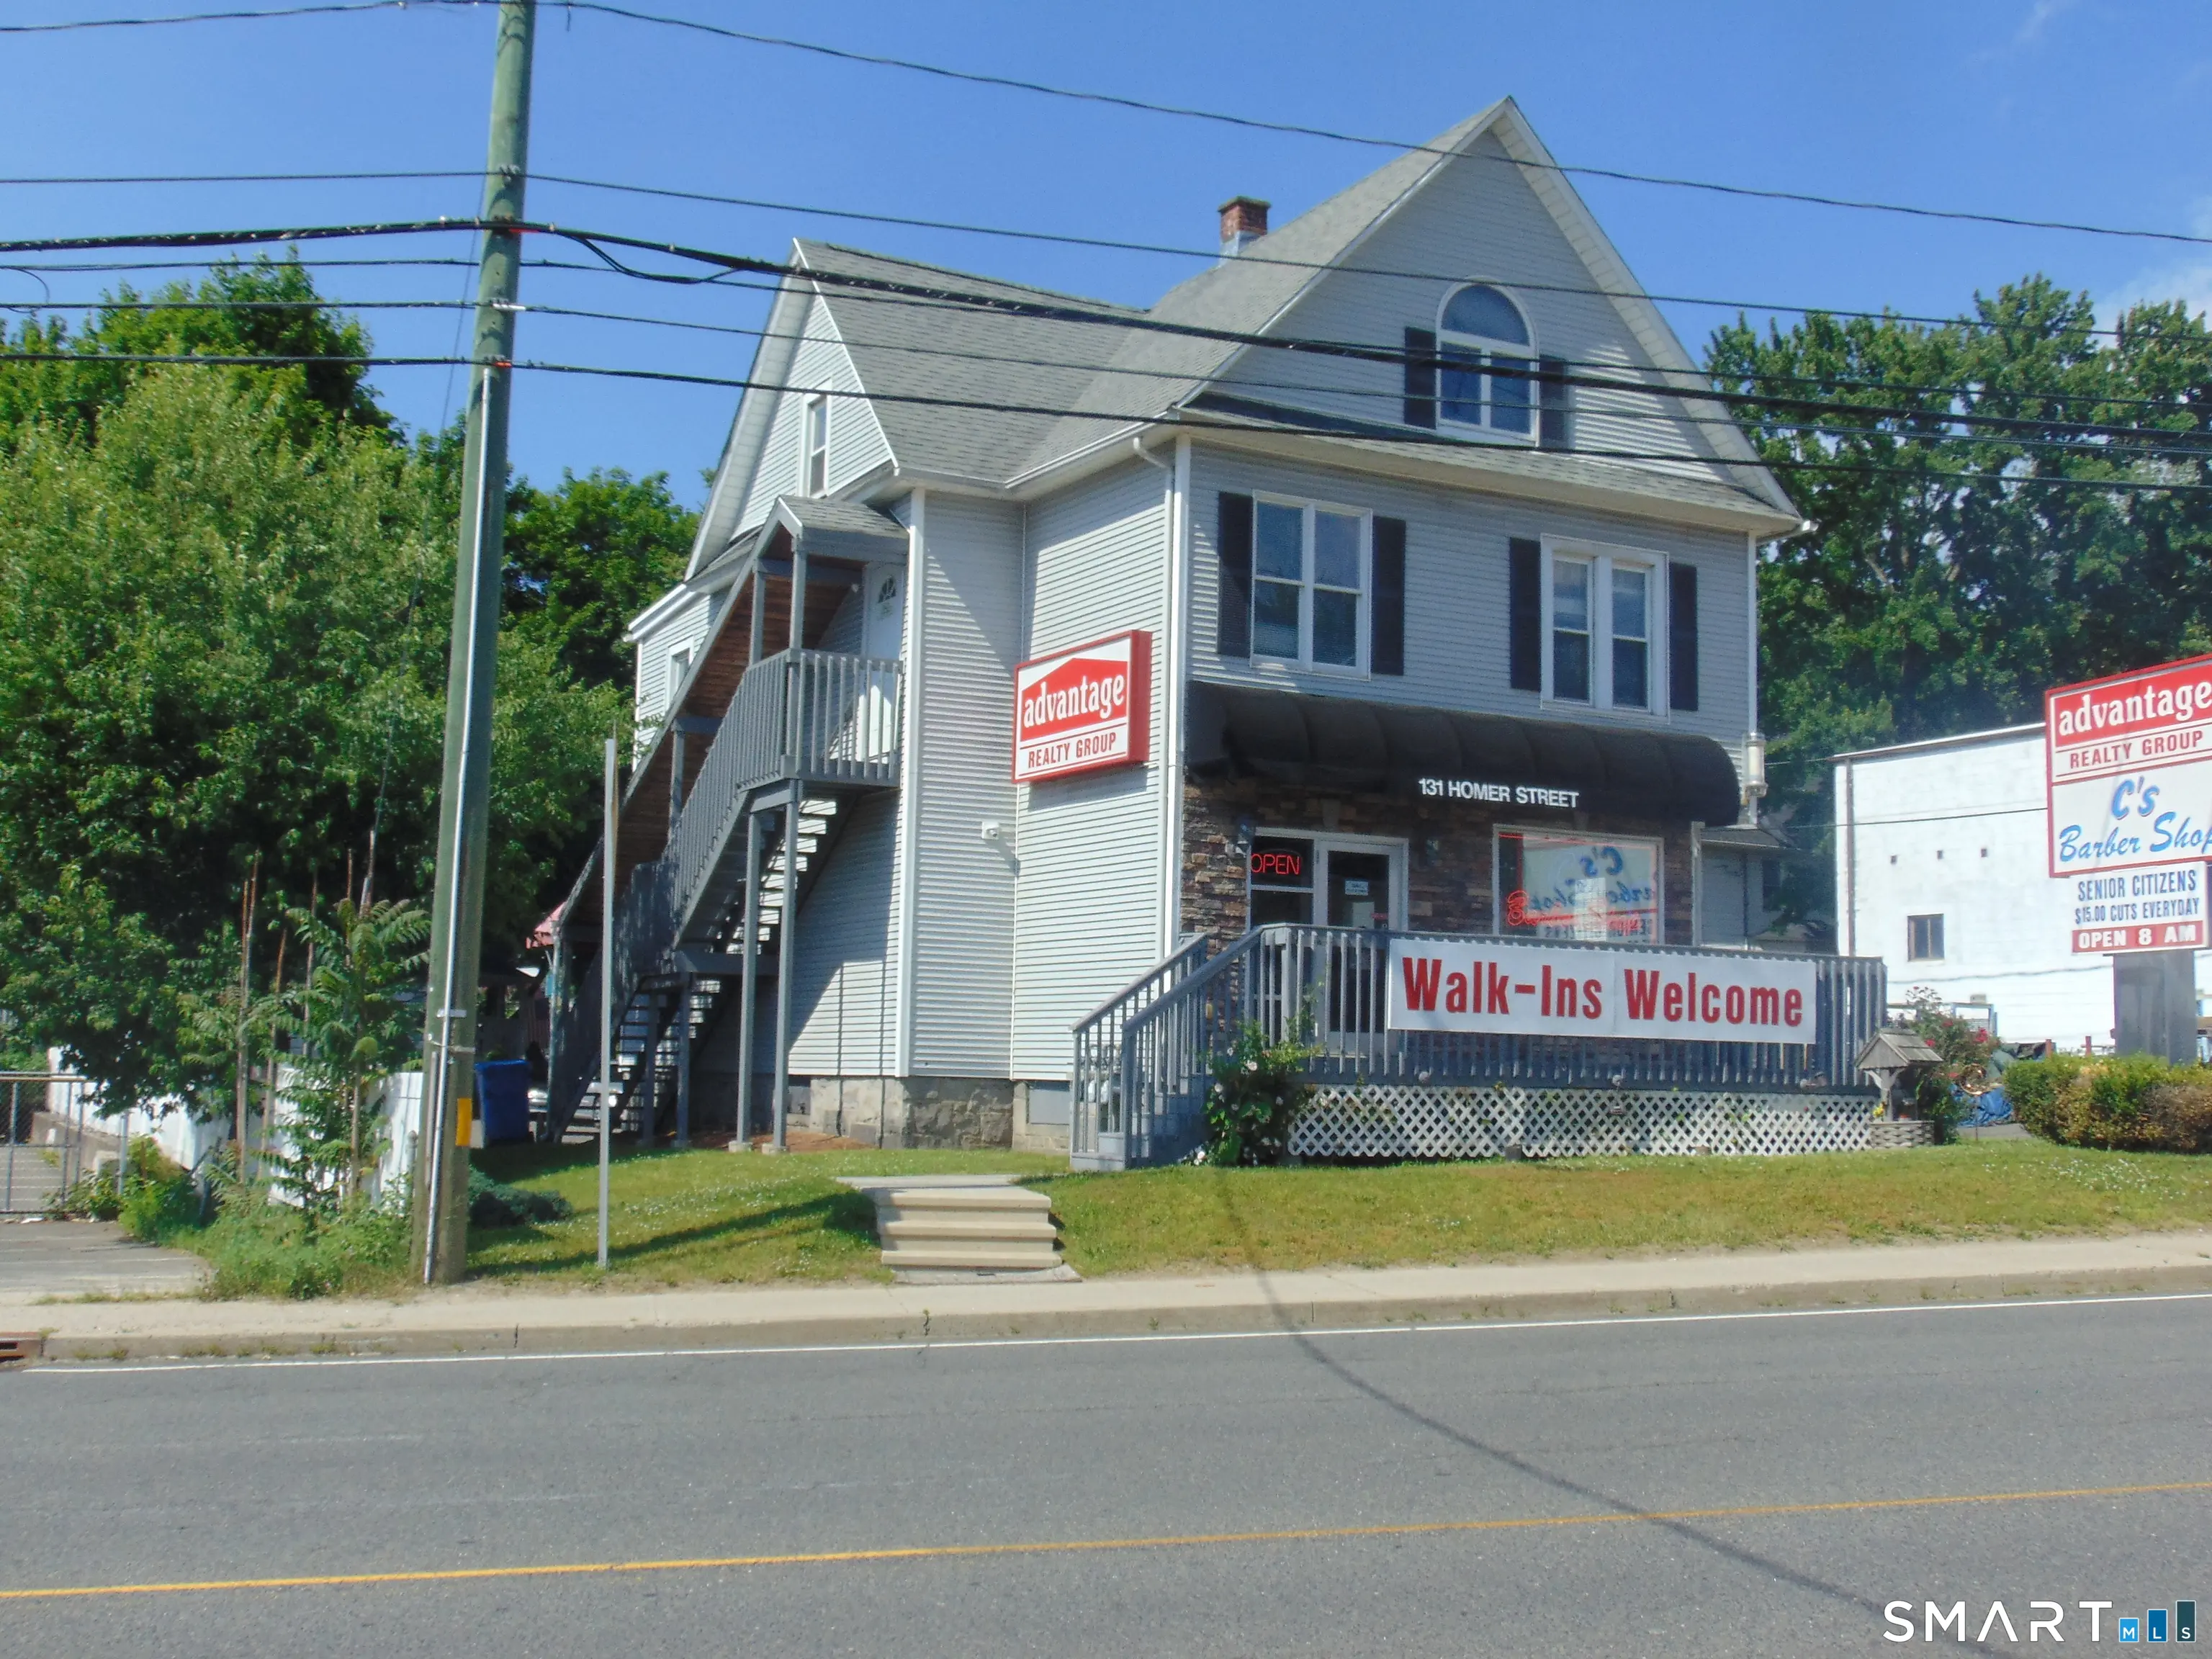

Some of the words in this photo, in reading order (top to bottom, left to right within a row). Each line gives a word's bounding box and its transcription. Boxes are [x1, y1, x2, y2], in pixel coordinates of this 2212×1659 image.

[1023, 675, 1125, 728] advantage
[2059, 681, 2212, 736] advantage
[1028, 743, 1071, 768] REALTY
[1076, 732, 1116, 758] GROUP
[2070, 742, 2132, 768] REALTY
[2142, 730, 2203, 755] GROUP
[1418, 778, 1443, 796] 131
[1448, 780, 1511, 802] HOMER
[1516, 786, 1580, 808] STREET
[2111, 775, 2160, 820] C's
[2059, 824, 2141, 862] Barber
[1251, 853, 1300, 875] OPEN
[2078, 876, 2125, 902] SENIOR
[2132, 869, 2196, 896] CITIZENS
[2075, 905, 2106, 925] $15.00
[2110, 903, 2137, 922] CUTS
[2143, 897, 2199, 919] EVERYDAY
[2079, 930, 2126, 949] OPEN
[2139, 927, 2152, 945] 8
[2164, 925, 2196, 943] AM
[1401, 957, 1603, 1020] Walk-Ins
[1624, 968, 1803, 1028] Welcome
